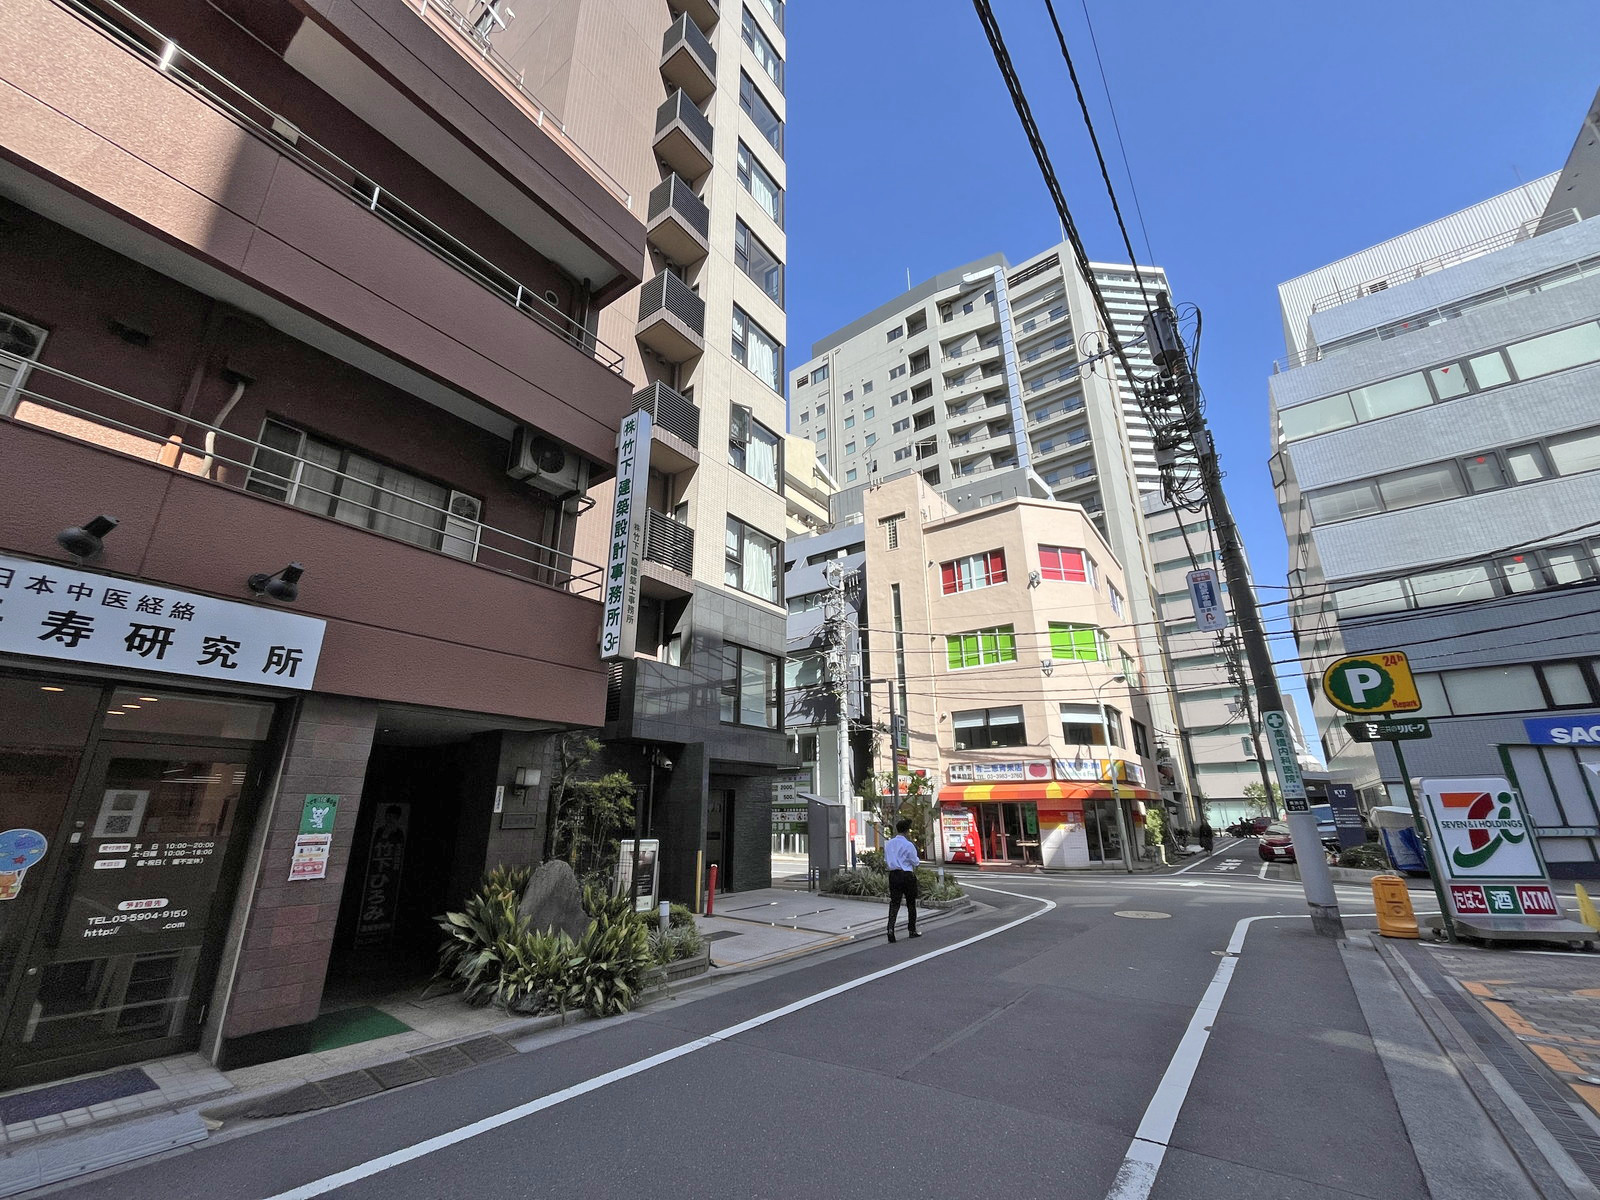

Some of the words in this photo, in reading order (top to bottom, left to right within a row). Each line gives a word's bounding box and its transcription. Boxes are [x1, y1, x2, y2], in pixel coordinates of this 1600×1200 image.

[0, 567, 196, 622] 日本中医経絡
[0, 598, 304, 678] 寿研究所
[604, 632, 619, 652] 3F
[1382, 654, 1404, 668] 24h
[1344, 667, 1382, 704] P
[1392, 699, 1418, 709] Repark
[898, 717, 906, 732] P
[1272, 728, 1297, 785] 高橋内科医院
[1478, 819, 1523, 829] HOLDINGS
[1453, 889, 1487, 910] たばこ
[1491, 889, 1514, 910] 酒
[1522, 889, 1552, 910] ATM
[83, 926, 121, 938] http://
[162, 921, 186, 930] .com
